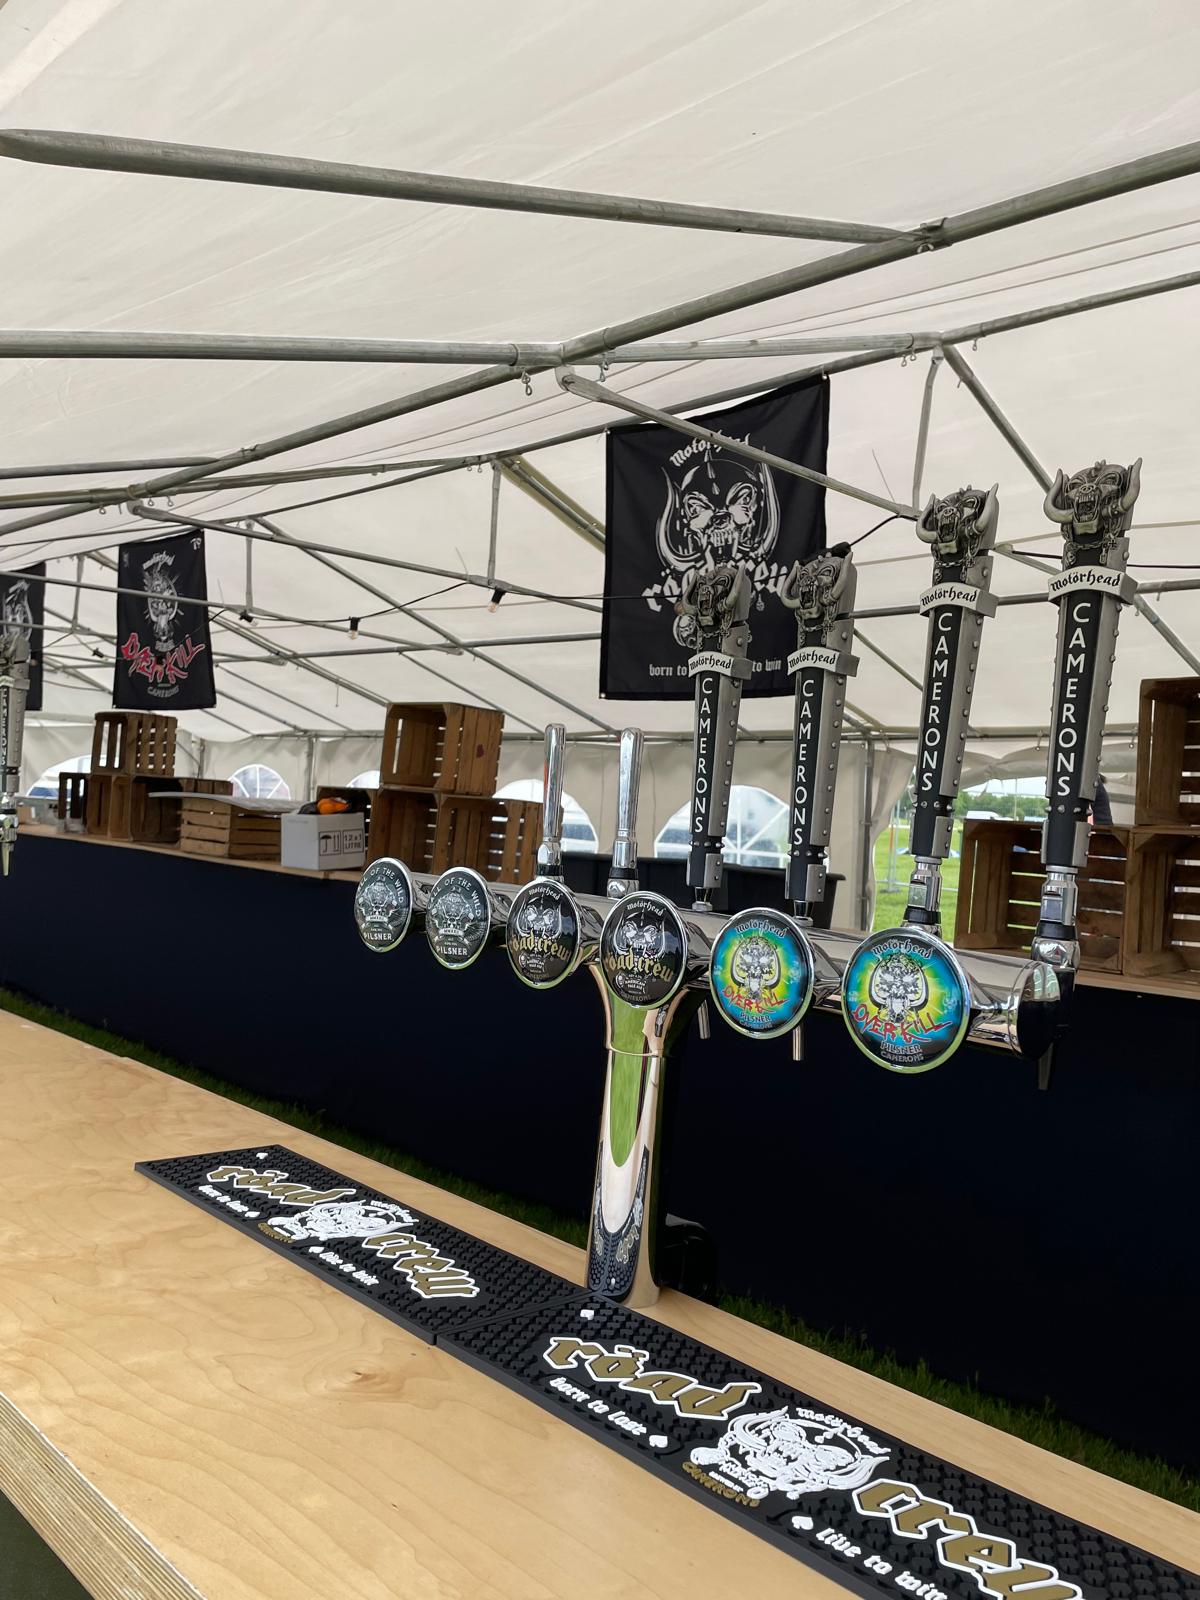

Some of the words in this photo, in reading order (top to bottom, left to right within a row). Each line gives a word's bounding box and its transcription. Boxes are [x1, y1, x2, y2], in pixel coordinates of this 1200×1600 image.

[1051, 569, 1121, 591] motörhead
[921, 586, 977, 607] motörhead
[649, 663, 673, 676] born
[690, 653, 732, 670] motörhead
[789, 650, 837, 668] motörhead
[922, 612, 953, 791] CAMERONS
[1056, 602, 1090, 797] CAMERONS
[694, 677, 713, 833] CAMERONS
[793, 679, 815, 845] CAMERONS
[370, 867, 381, 876] OF
[382, 867, 396, 880] THE
[394, 879, 404, 904] WILD
[444, 877, 455, 886] OF
[458, 877, 472, 891] THE
[471, 890, 482, 917] WILD
[363, 932, 392, 941] PILSNER
[436, 945, 468, 956] PILSNER
[872, 939, 934, 959] motörhead
[740, 1012, 772, 1022] PILSNER
[880, 1040, 923, 1054] PILSNER
[880, 1051, 924, 1063] CAMERONS
[549, 1375, 591, 1403] born
[588, 1399, 610, 1414] to
[815, 1526, 863, 1559] live
[863, 1554, 893, 1576] to
